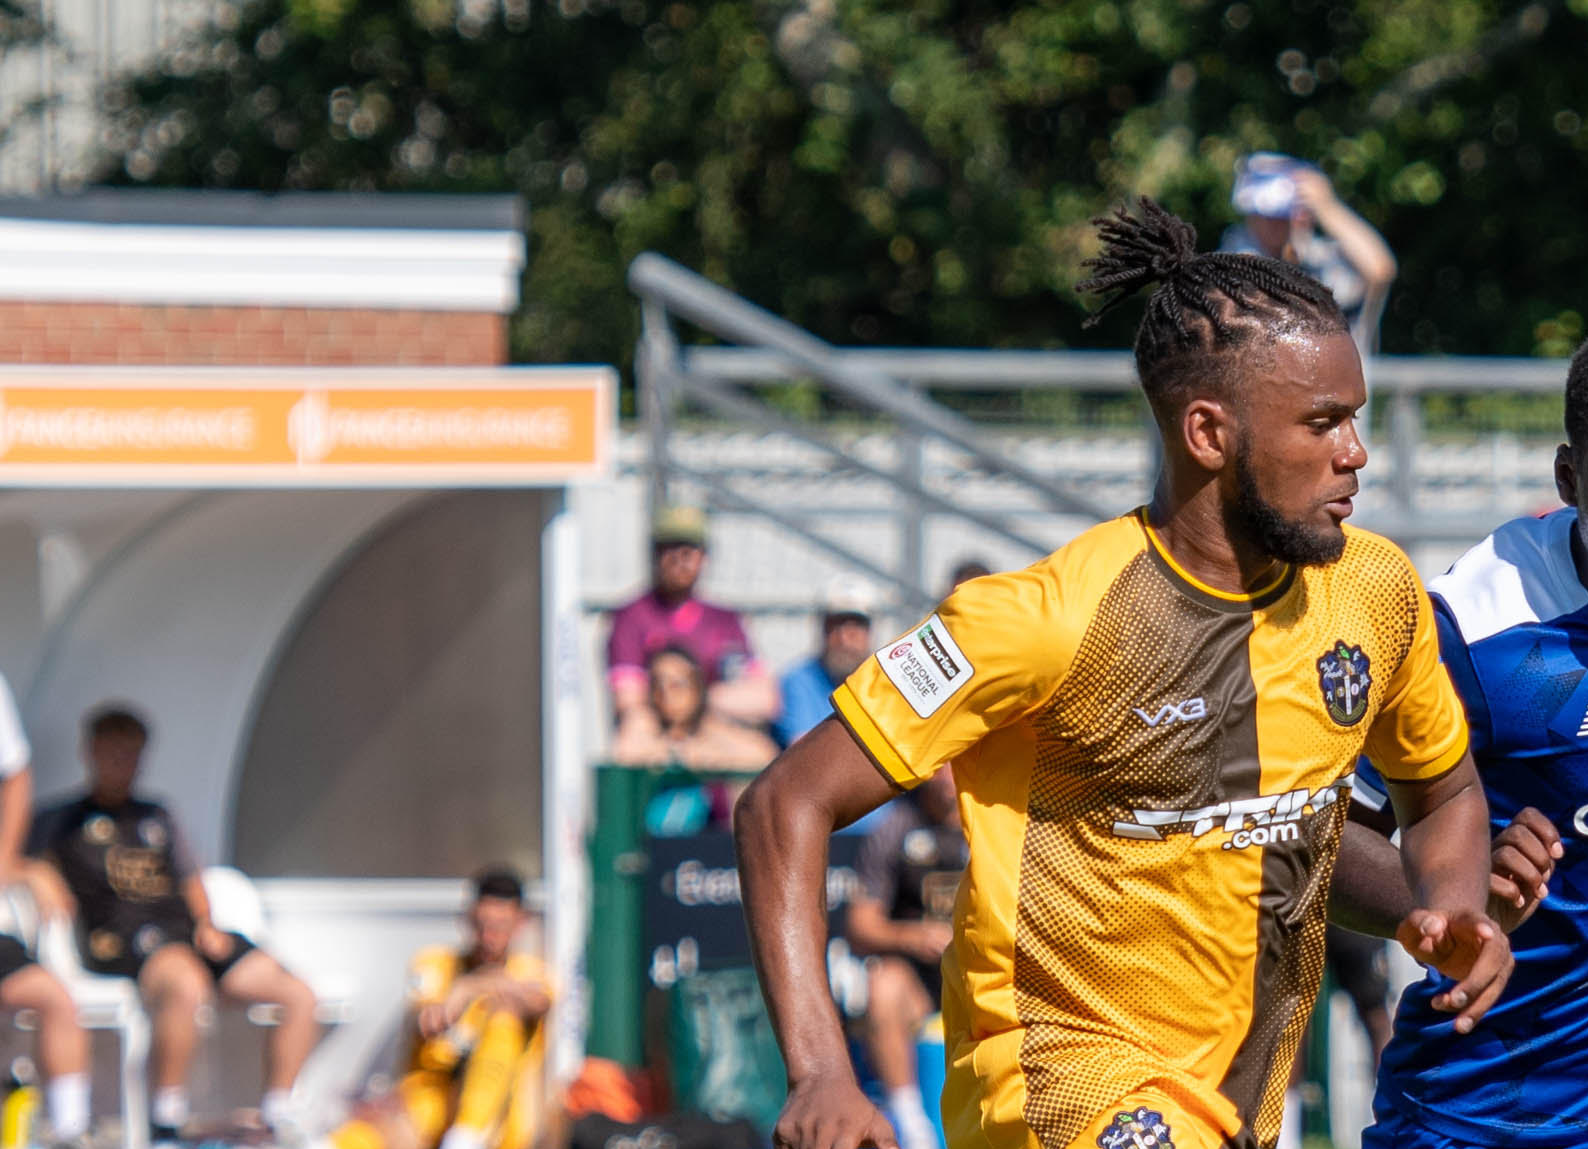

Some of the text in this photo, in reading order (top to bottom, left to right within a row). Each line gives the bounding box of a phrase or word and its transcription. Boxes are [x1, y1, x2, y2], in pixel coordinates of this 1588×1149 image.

[899, 660, 931, 697] LEAGUE
[905, 652, 940, 696] NATIONAL
[1132, 697, 1208, 727] VX3
